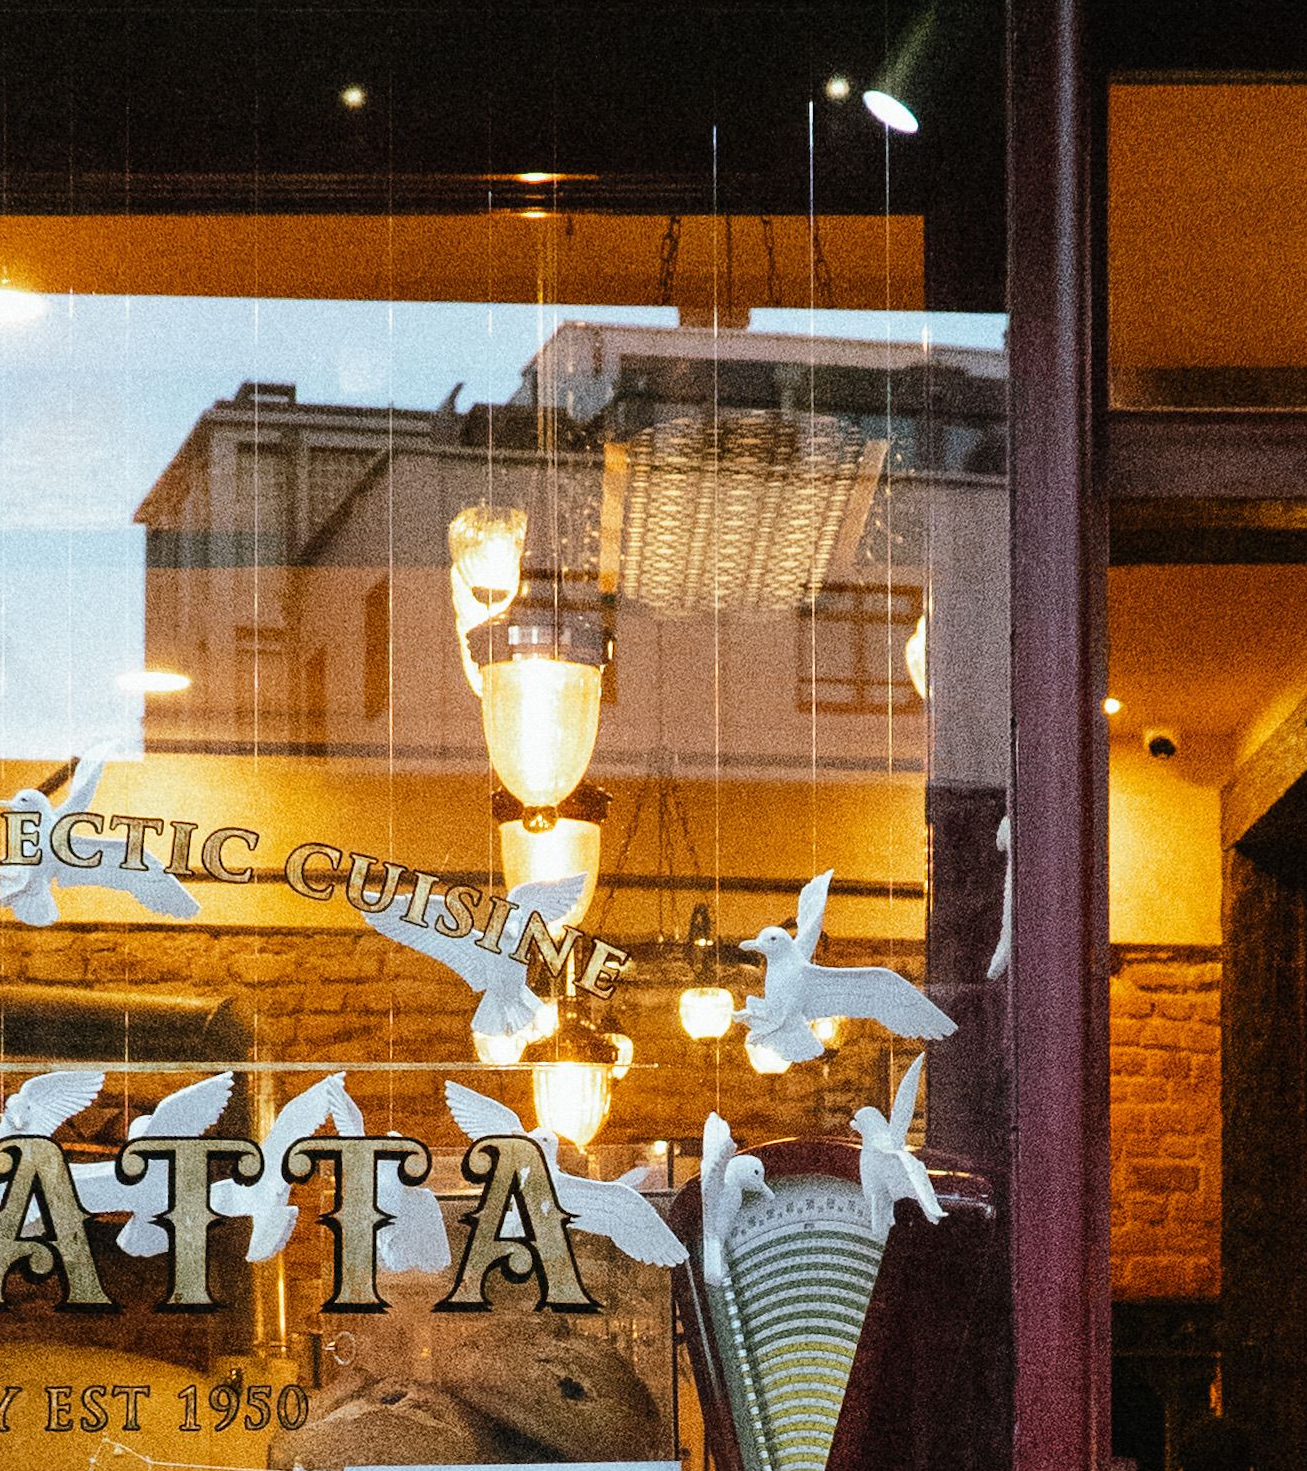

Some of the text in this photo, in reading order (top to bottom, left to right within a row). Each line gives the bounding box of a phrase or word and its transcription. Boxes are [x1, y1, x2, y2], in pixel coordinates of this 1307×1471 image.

[284, 841, 630, 1001] CUISINE
[44, 1384, 150, 1434] EST
[179, 1384, 311, 1435] 1950
